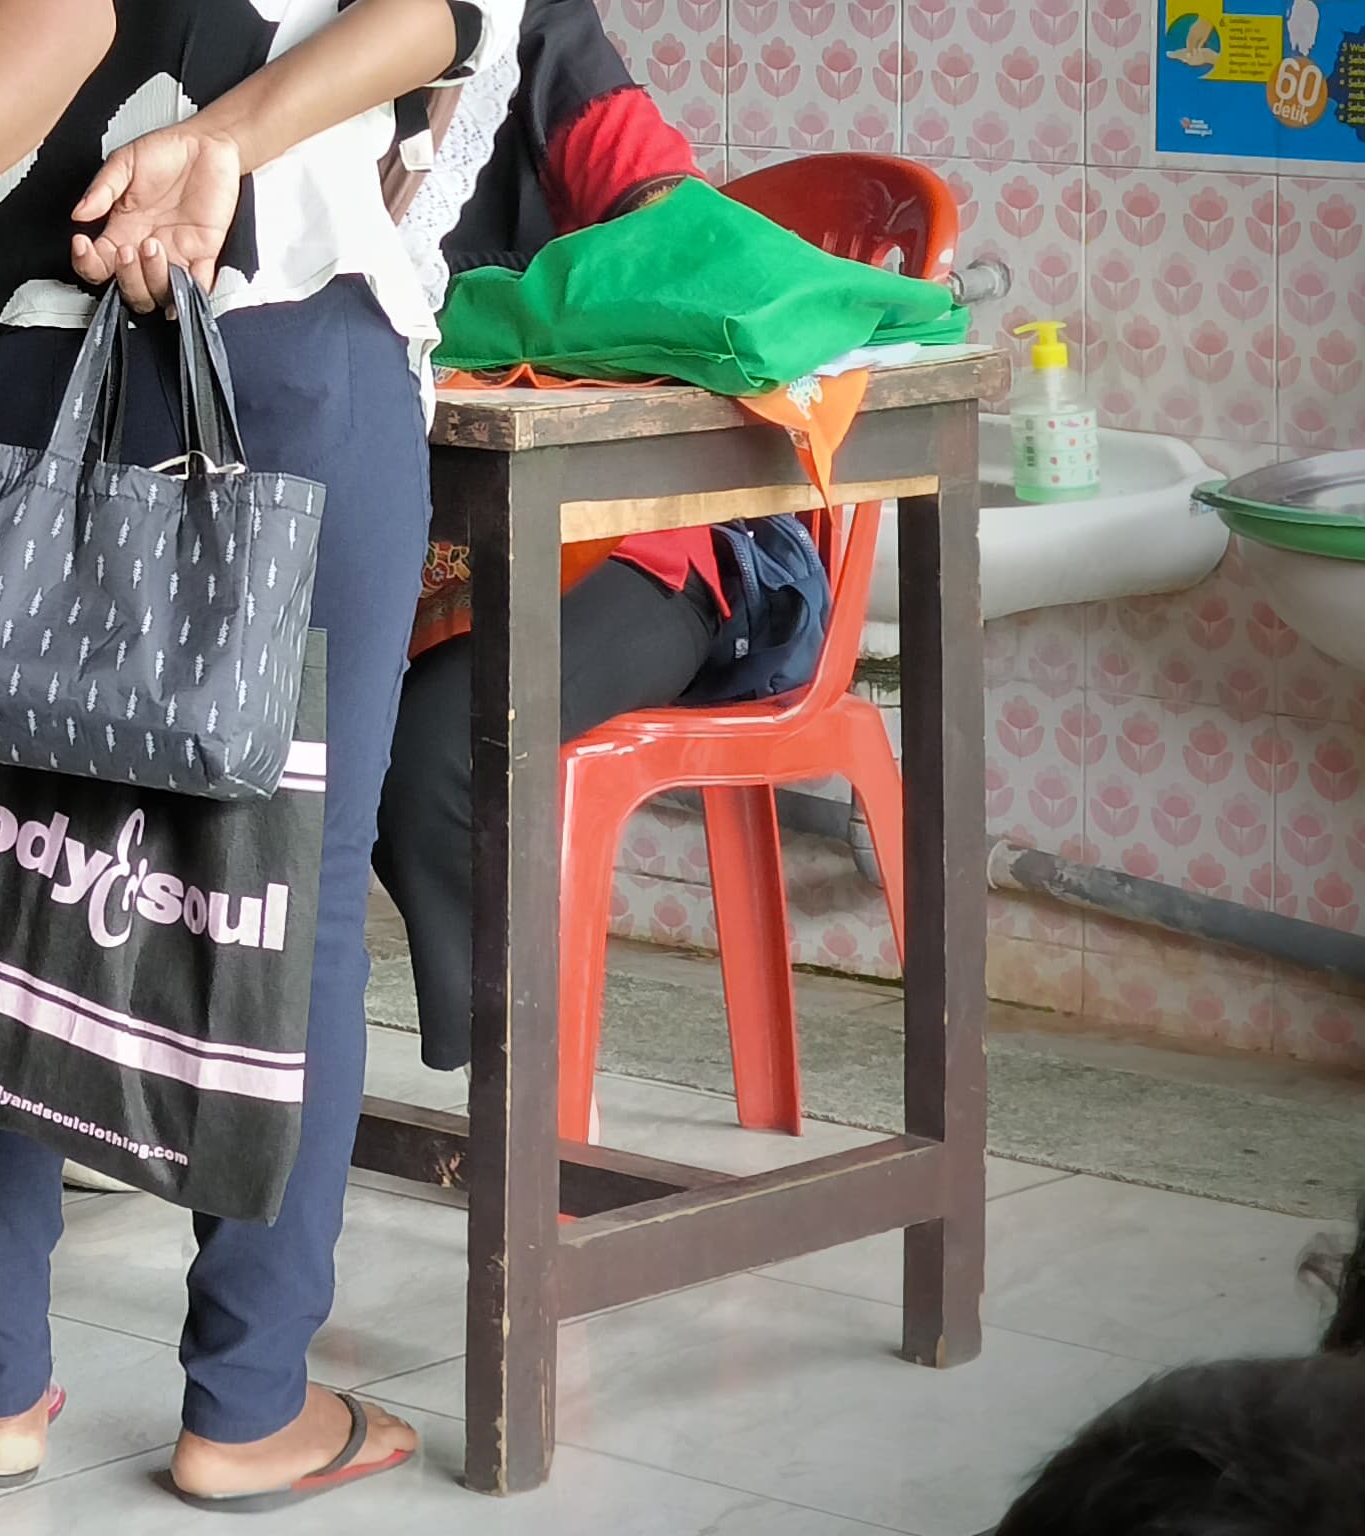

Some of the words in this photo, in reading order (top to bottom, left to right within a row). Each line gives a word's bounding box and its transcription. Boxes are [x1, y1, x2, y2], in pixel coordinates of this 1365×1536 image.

[1275, 58, 1322, 107] 60
[1273, 99, 1309, 125] detik
[136, 860, 289, 951] soul
